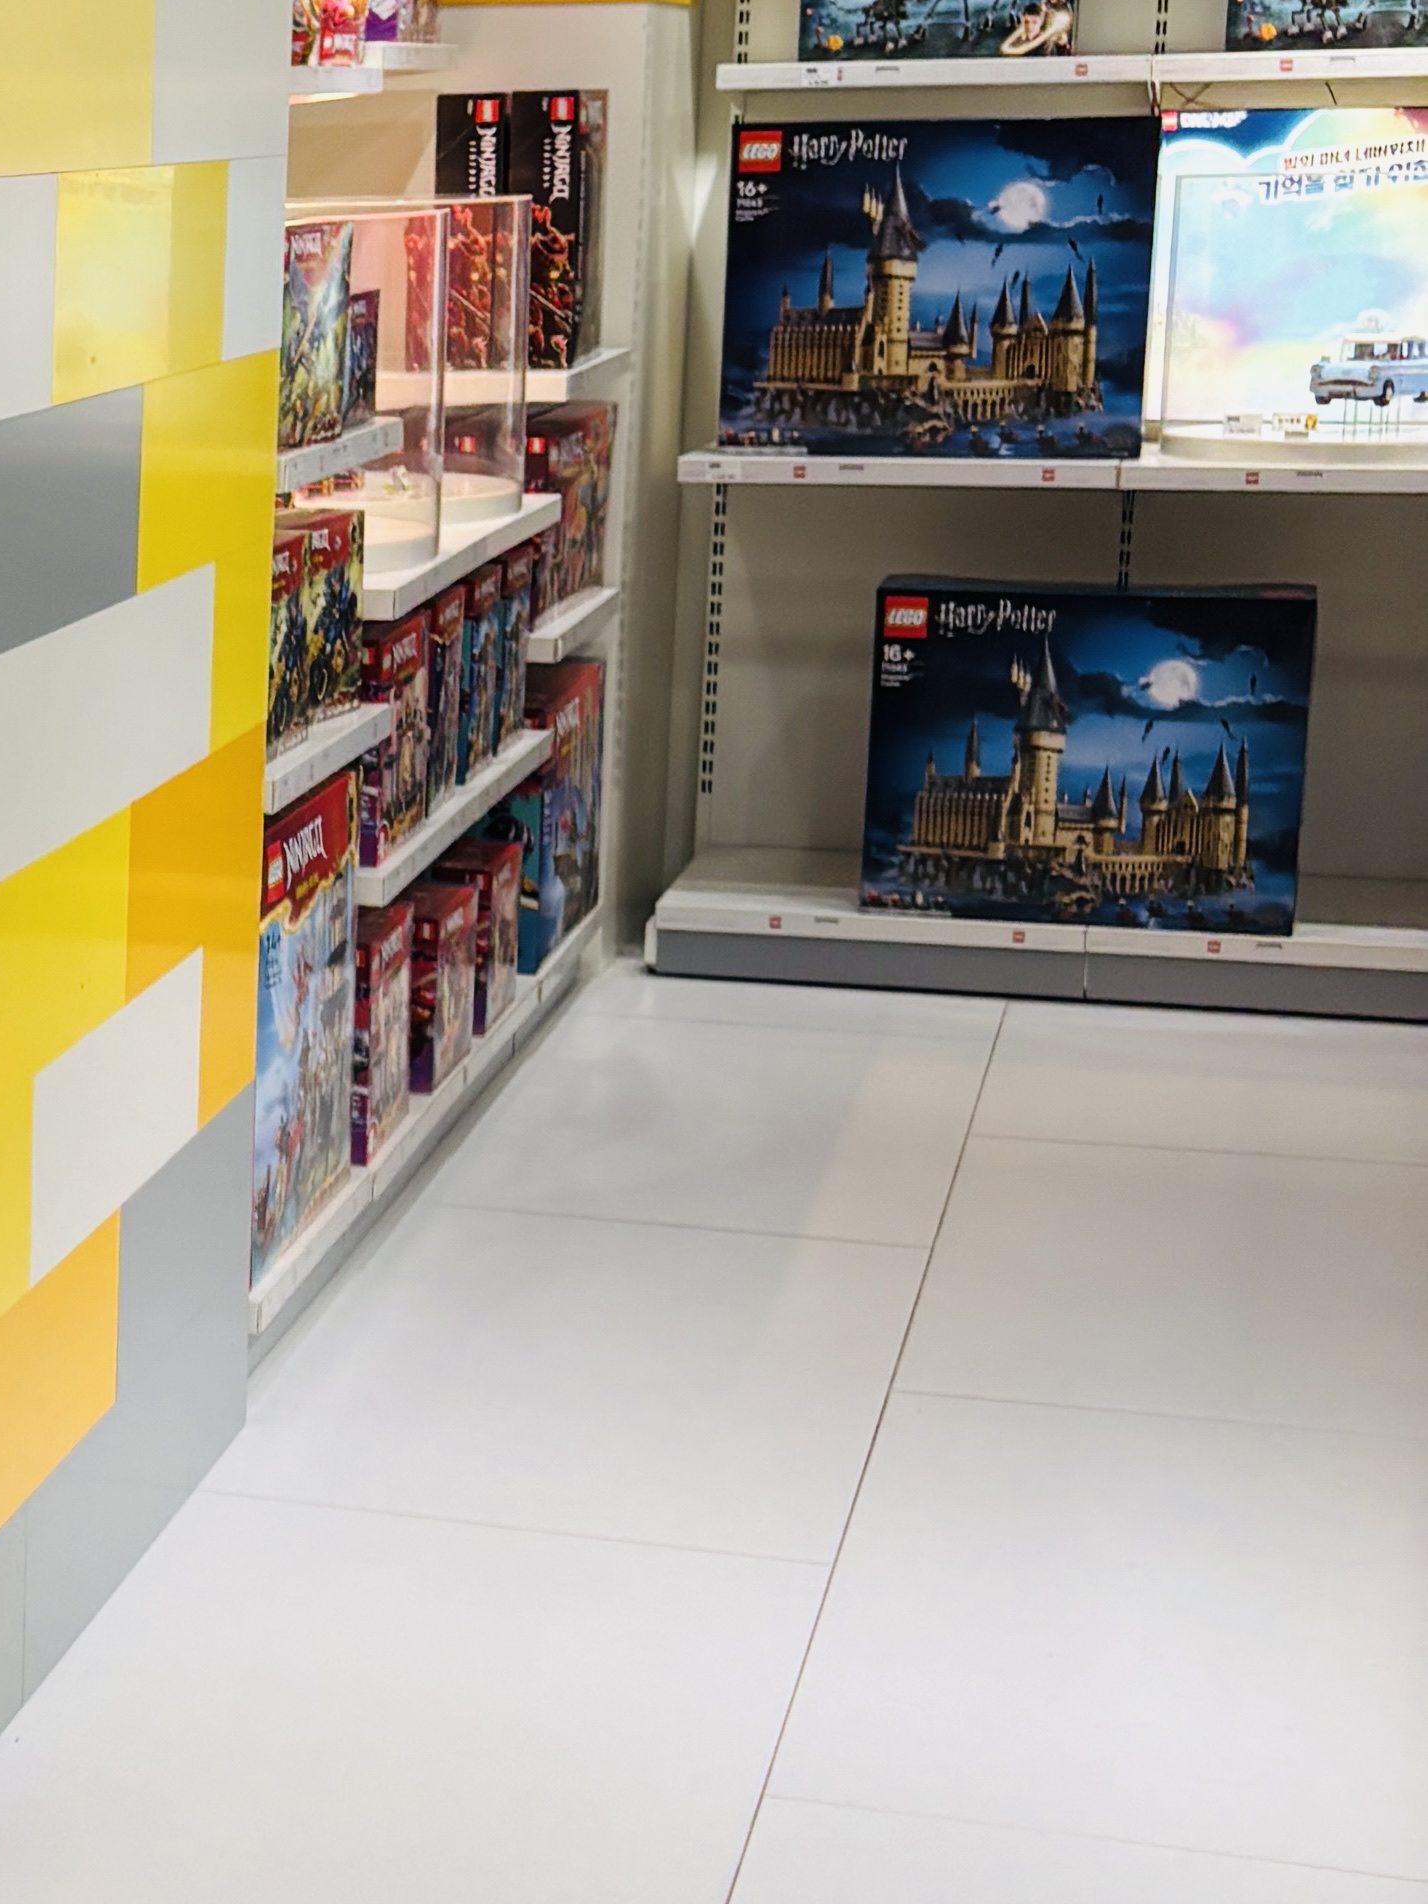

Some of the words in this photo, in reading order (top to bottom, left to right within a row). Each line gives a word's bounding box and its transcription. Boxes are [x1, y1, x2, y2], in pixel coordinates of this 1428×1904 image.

[741, 142, 781, 162] LEGO
[788, 131, 847, 170] Harry
[846, 129, 909, 162] Potter
[736, 180, 768, 199] 16+
[885, 607, 928, 628] LEGO
[936, 598, 996, 639] Harry
[994, 600, 1058, 634] Potter
[881, 643, 916, 663] 16+
